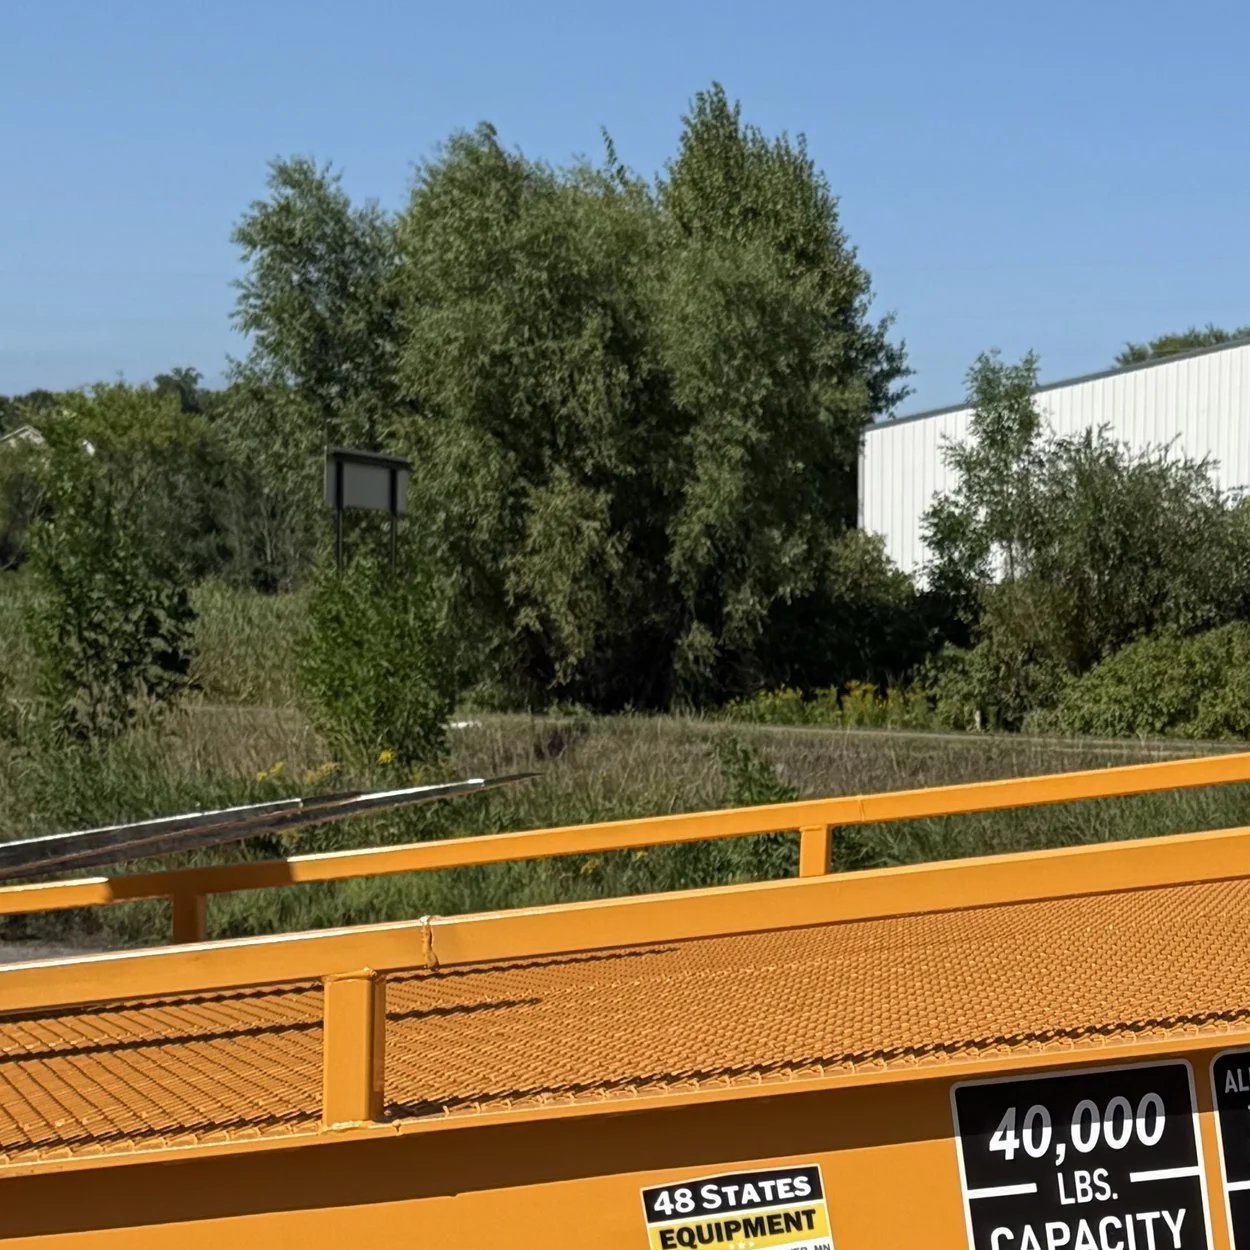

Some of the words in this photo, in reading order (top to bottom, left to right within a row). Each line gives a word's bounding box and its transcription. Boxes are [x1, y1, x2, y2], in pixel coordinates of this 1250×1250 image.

[989, 1092, 1166, 1166] 40,000
[654, 1188, 695, 1215] 48
[701, 1176, 812, 1209] STATES
[1057, 1168, 1118, 1205] LBS.
[659, 1209, 816, 1250] EQUIPMENT
